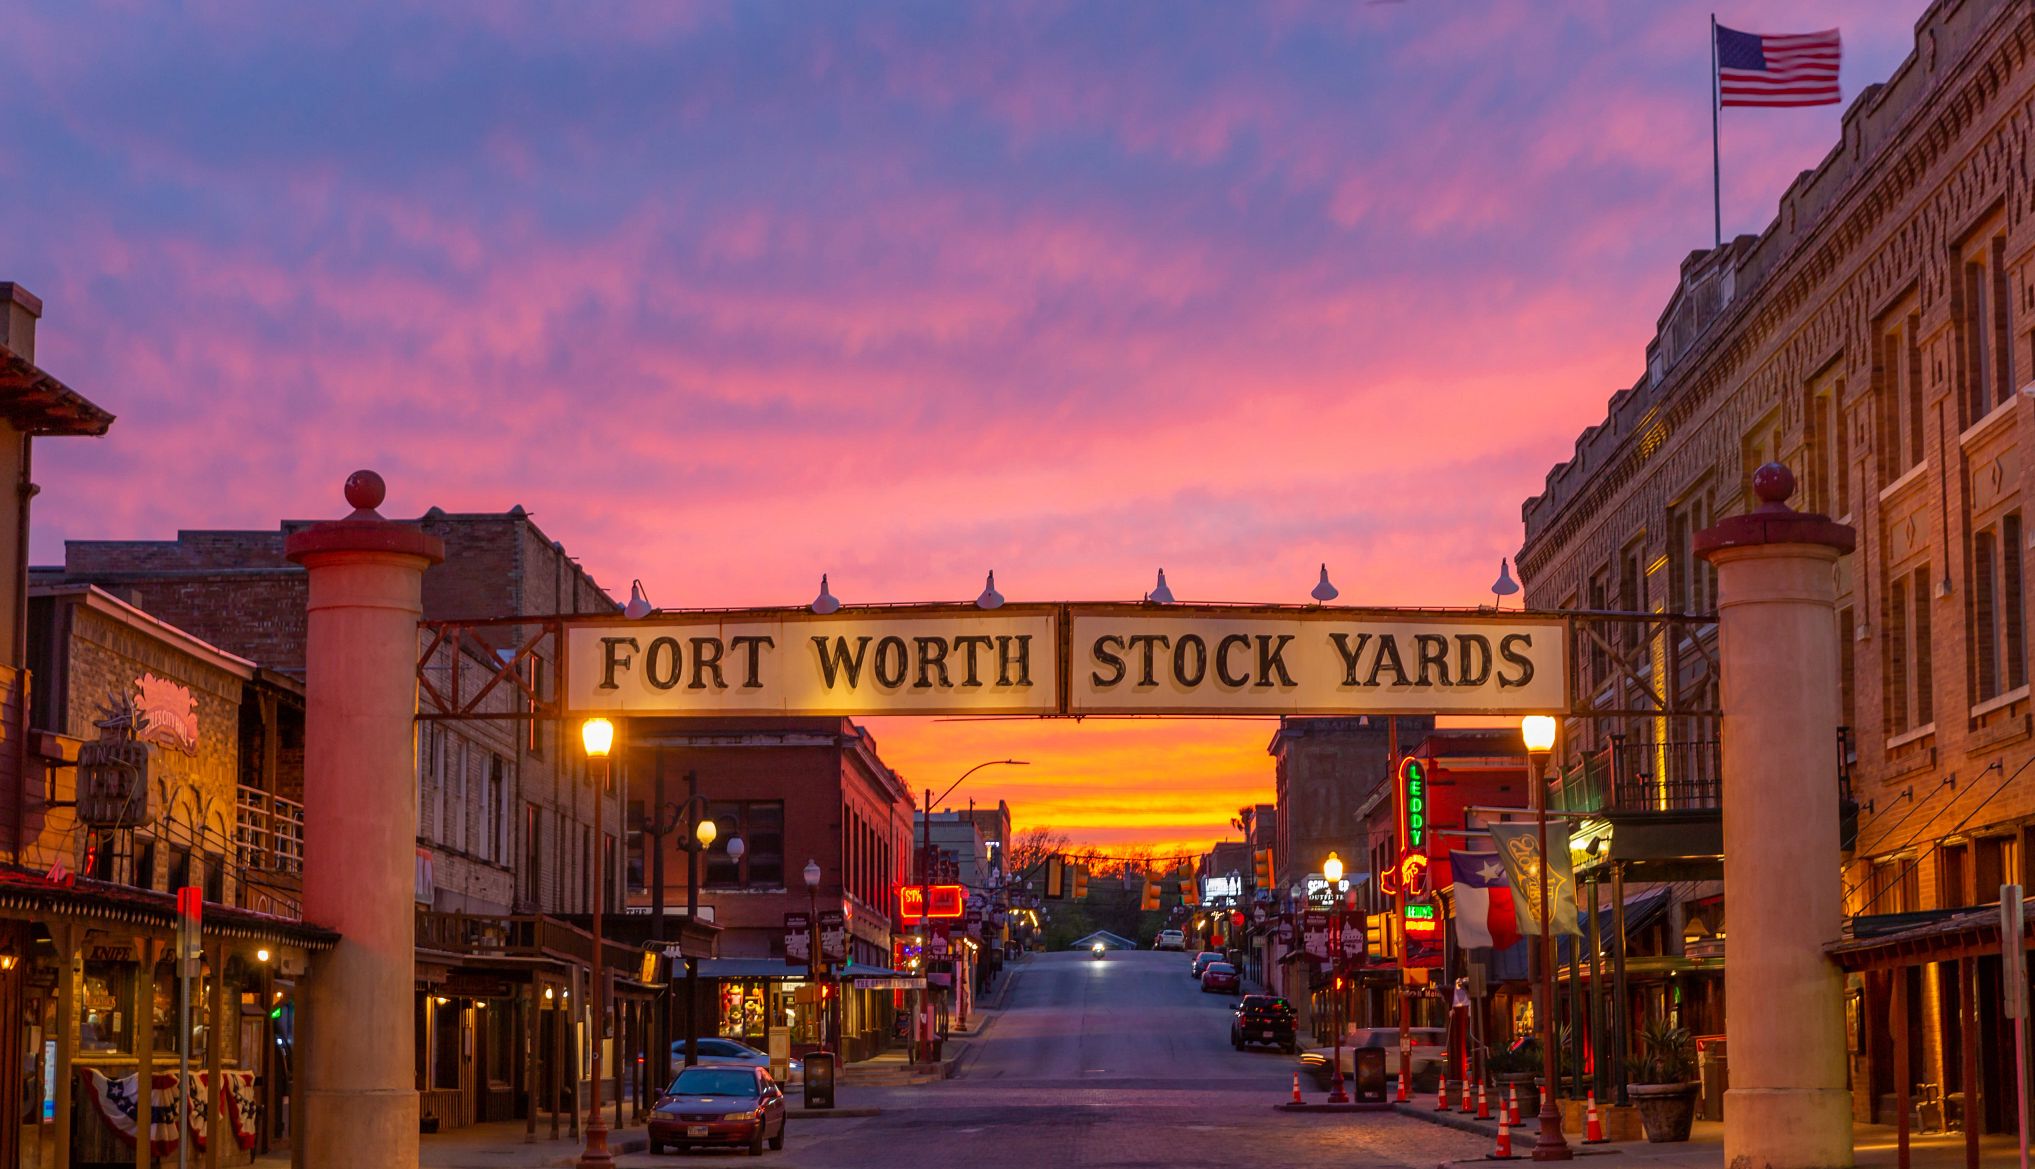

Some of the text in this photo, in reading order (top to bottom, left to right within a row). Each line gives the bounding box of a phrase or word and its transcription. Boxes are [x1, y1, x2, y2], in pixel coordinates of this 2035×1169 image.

[599, 632, 1535, 689] FORT WORTH STOCK YARDS
[1409, 764, 1423, 847] LEDDY
[91, 945, 132, 961] KNIFE
